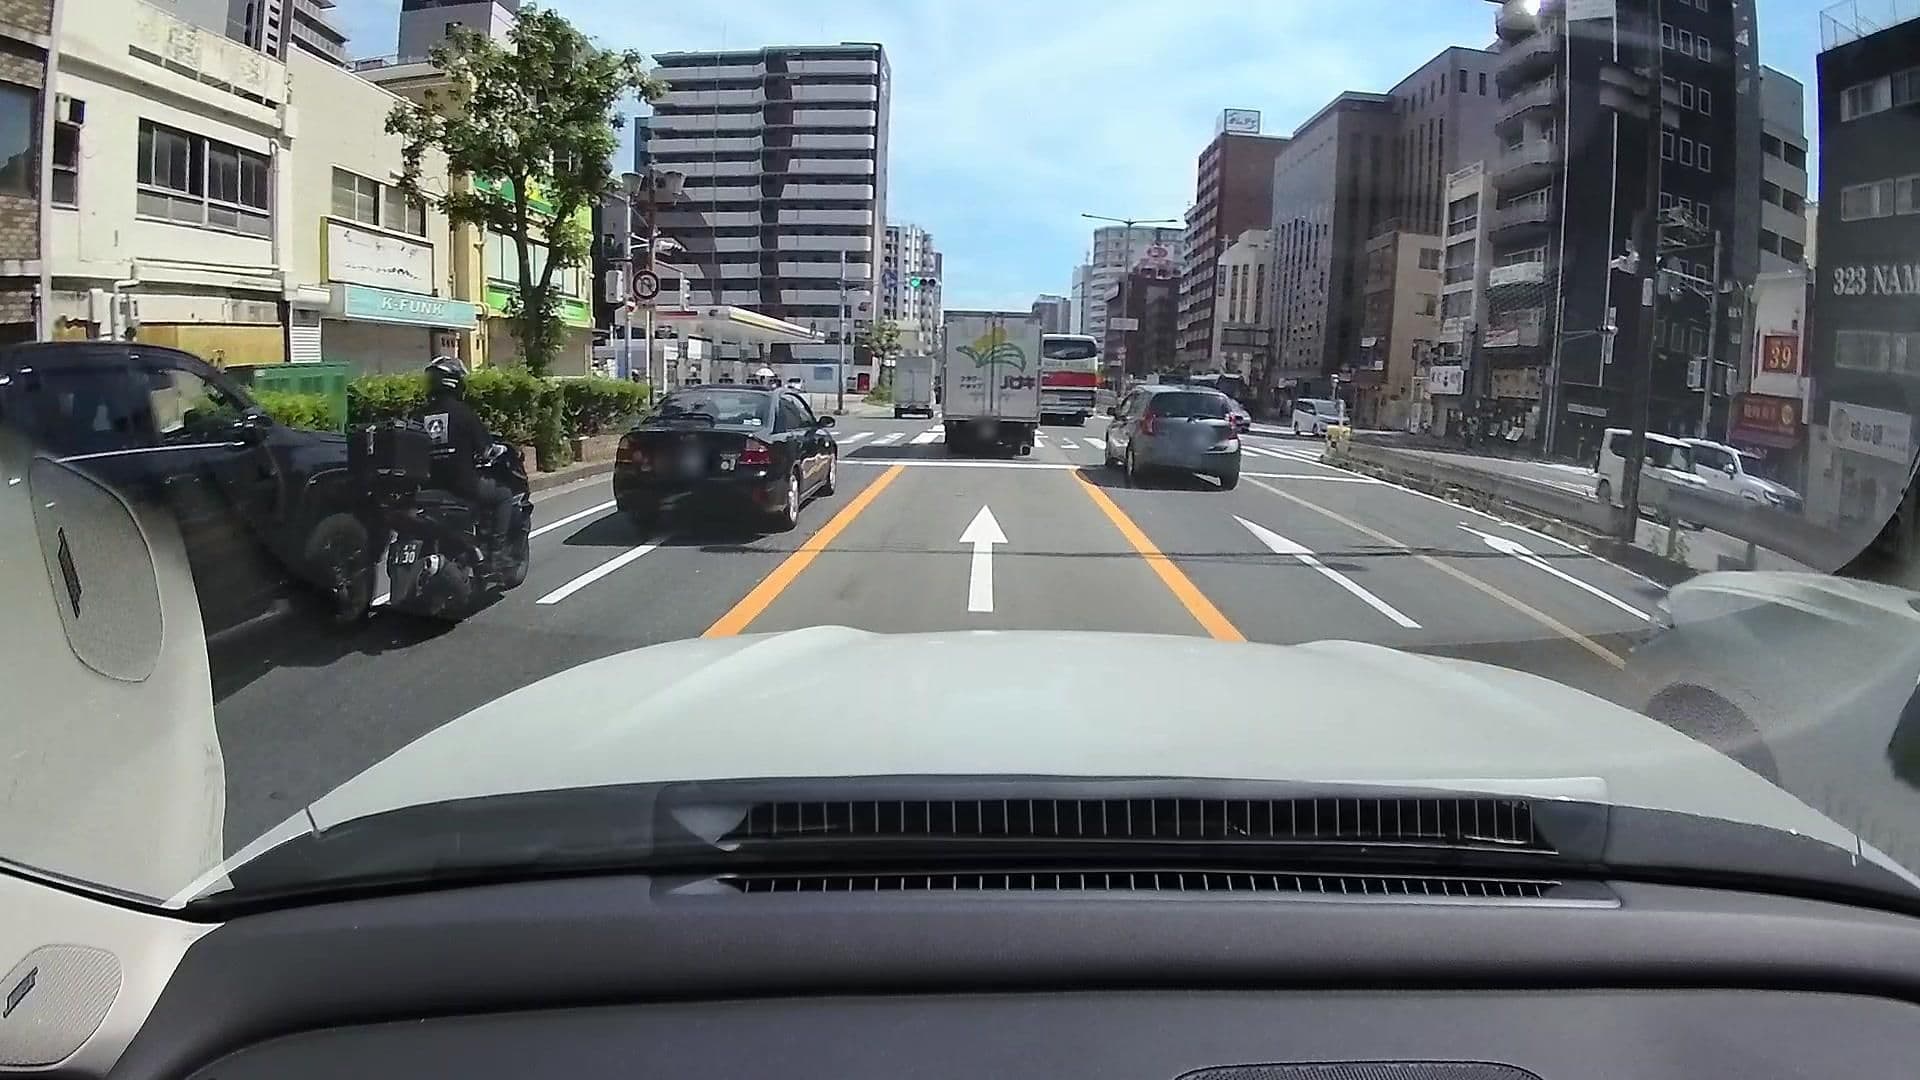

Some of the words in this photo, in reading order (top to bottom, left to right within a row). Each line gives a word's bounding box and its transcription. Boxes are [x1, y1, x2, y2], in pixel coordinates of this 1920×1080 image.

[1833, 266, 1867, 295] 323
[382, 297, 444, 316] K-FUNK
[1769, 346, 1792, 369] 39
